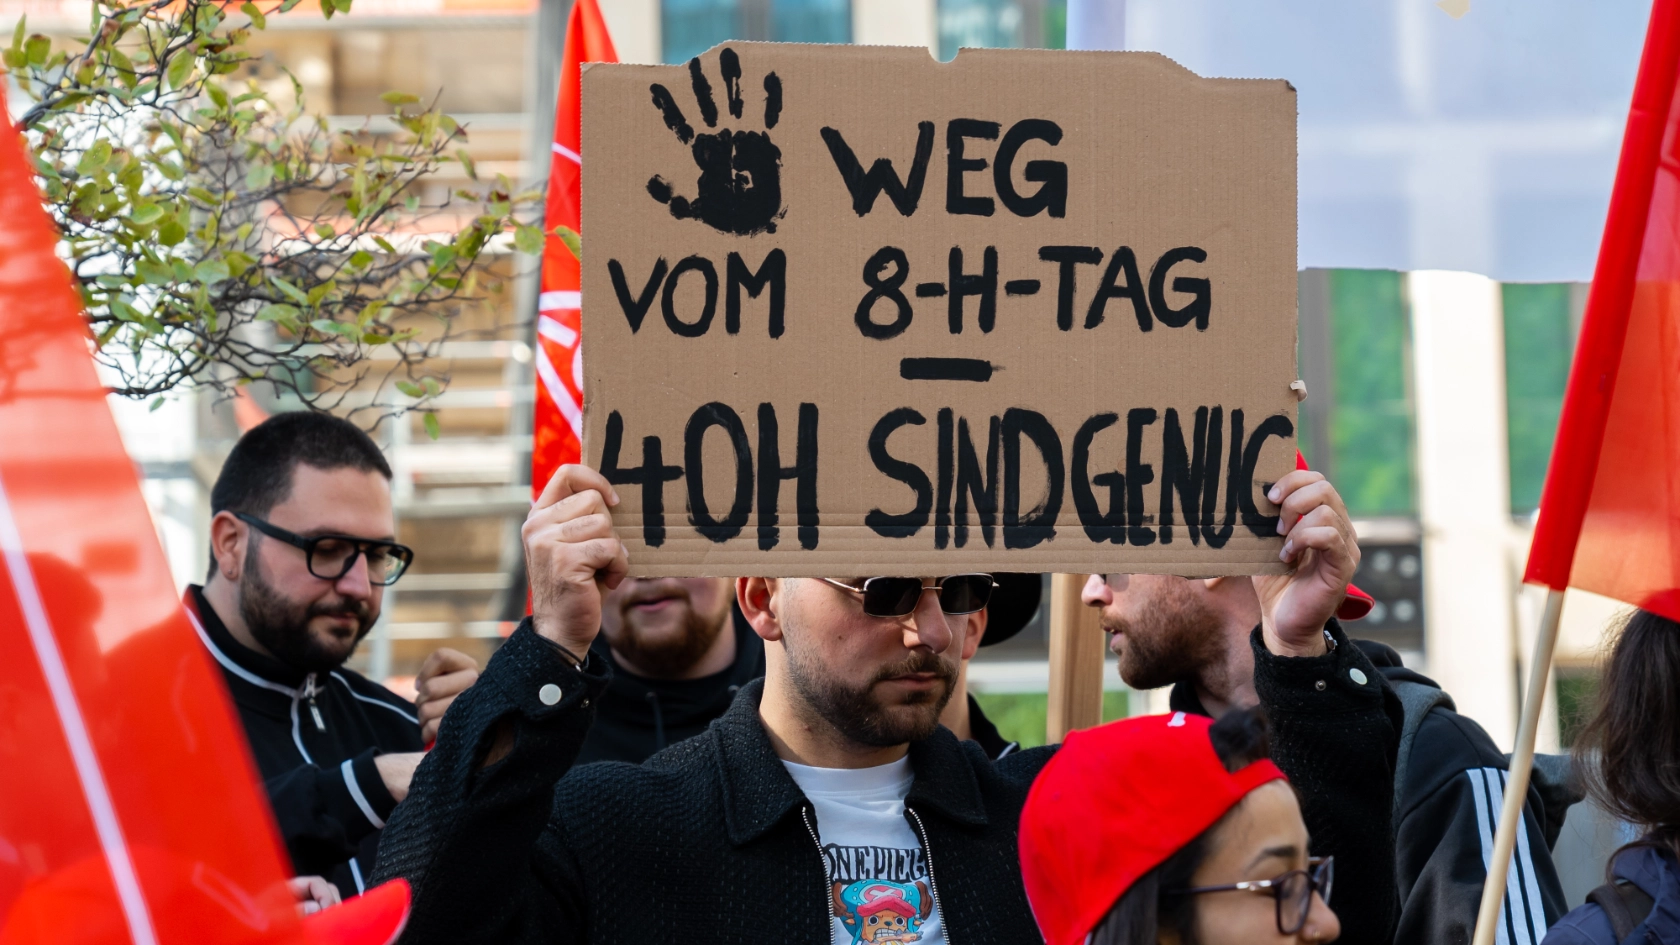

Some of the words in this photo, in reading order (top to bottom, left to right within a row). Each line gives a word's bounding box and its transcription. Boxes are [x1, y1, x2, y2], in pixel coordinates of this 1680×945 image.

[820, 118, 1067, 218] WEG
[608, 248, 787, 339] VOM
[855, 246, 1211, 340] 8-H-TAG
[865, 407, 1065, 549] SIND
